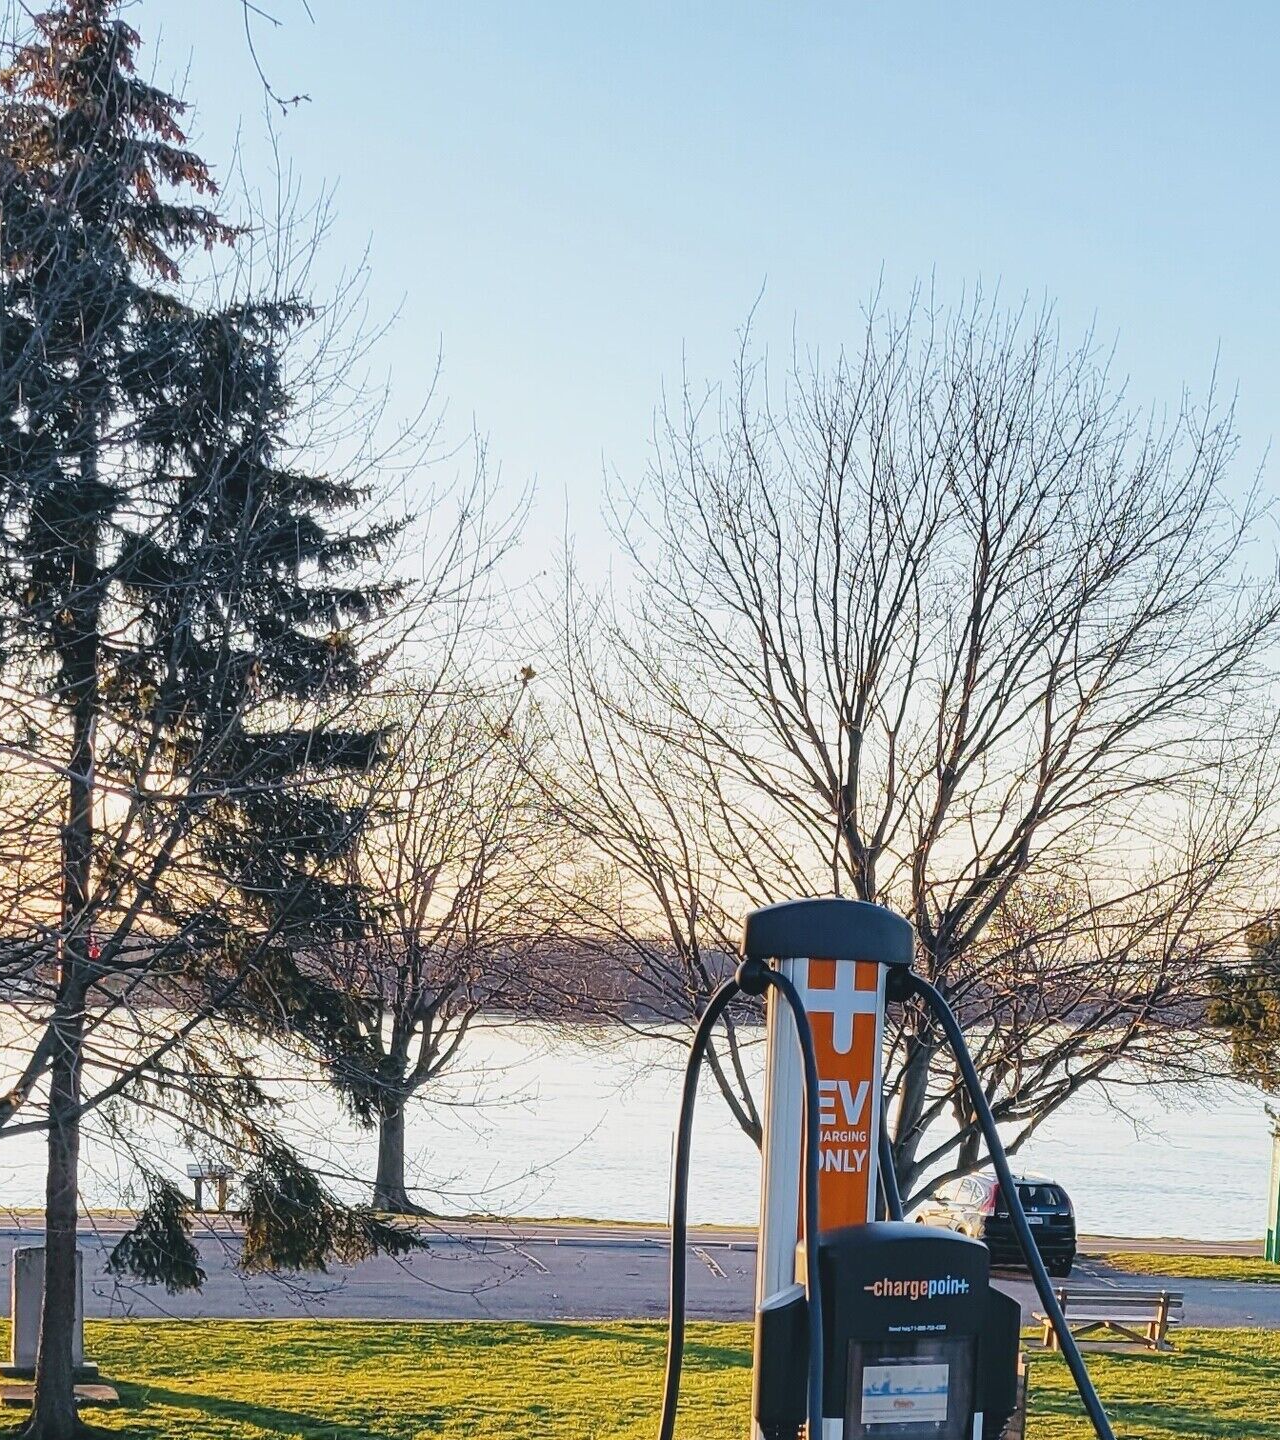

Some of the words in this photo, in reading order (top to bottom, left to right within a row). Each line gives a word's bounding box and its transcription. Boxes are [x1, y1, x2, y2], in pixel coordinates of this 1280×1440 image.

[818, 1080, 870, 1125] EV
[820, 1131, 867, 1142] ARGING
[864, 1275, 969, 1300] chargepoint
